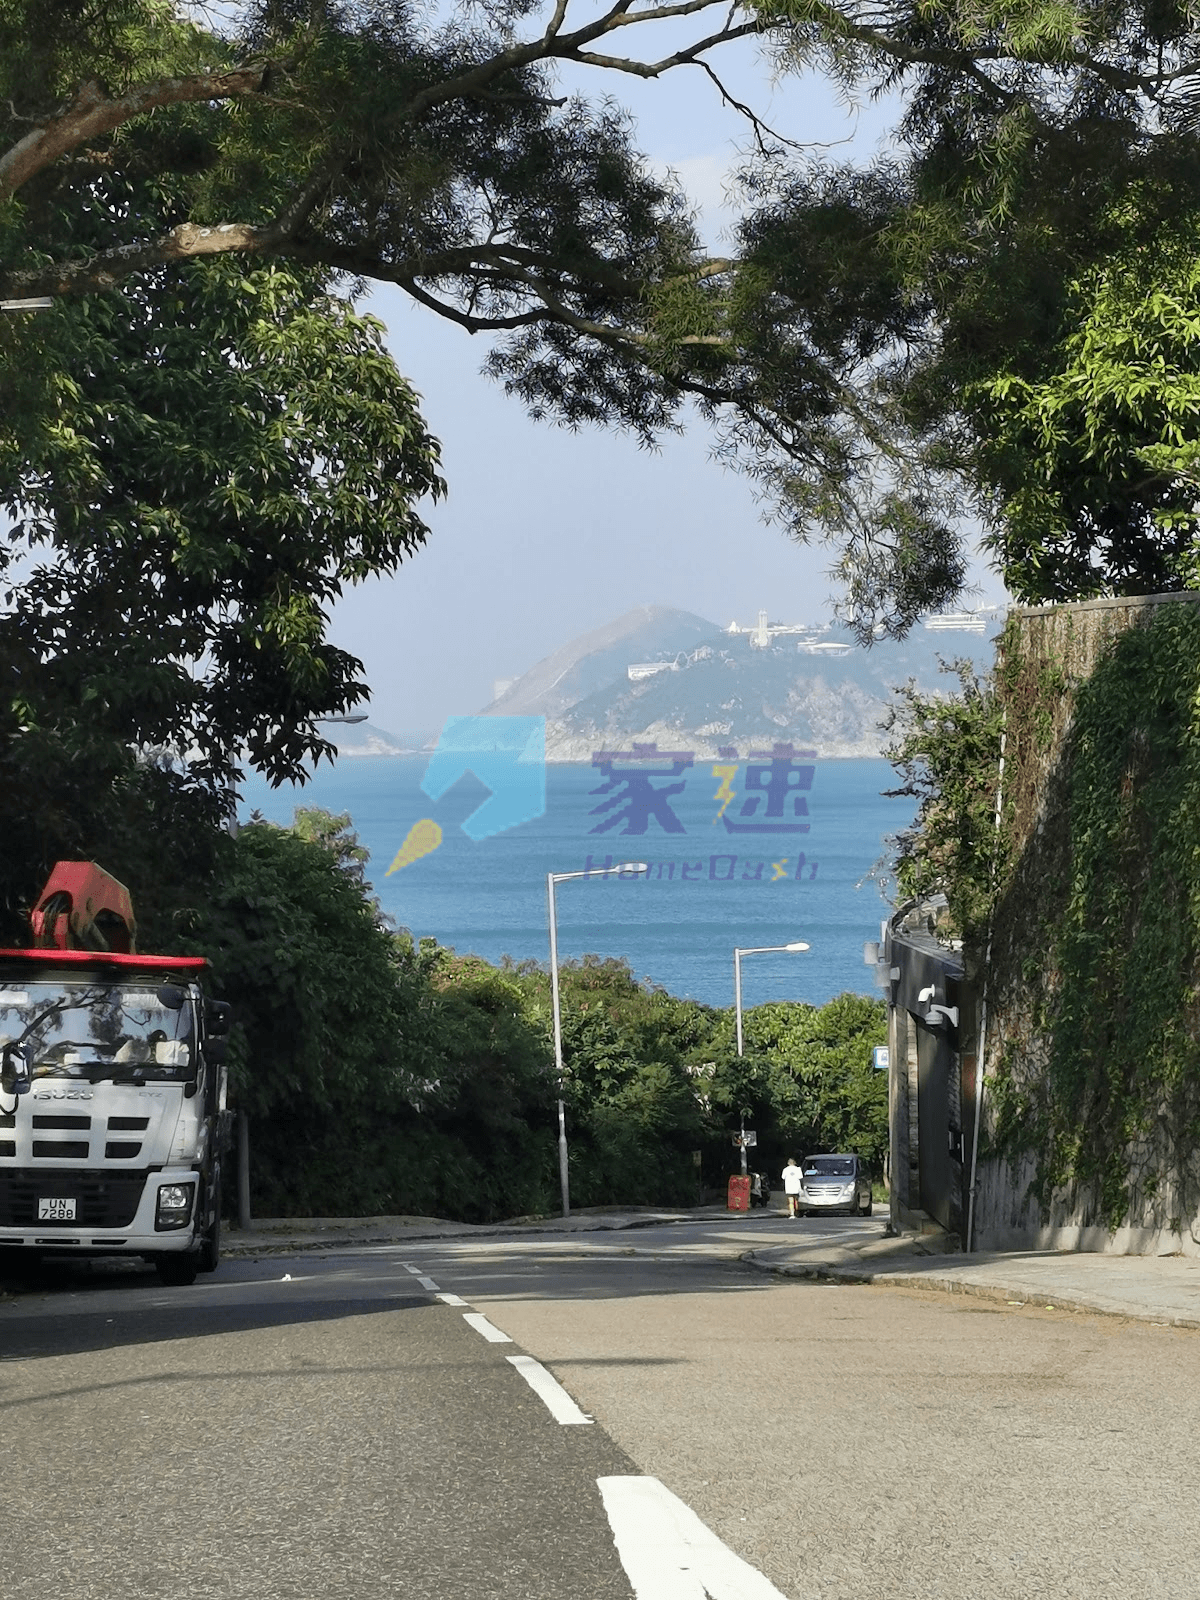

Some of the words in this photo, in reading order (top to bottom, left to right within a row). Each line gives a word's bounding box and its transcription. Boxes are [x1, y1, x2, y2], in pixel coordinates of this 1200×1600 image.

[32, 1088, 94, 1100] ISUZU
[49, 1199, 67, 1209] UN
[41, 1208, 74, 1219] 7288
